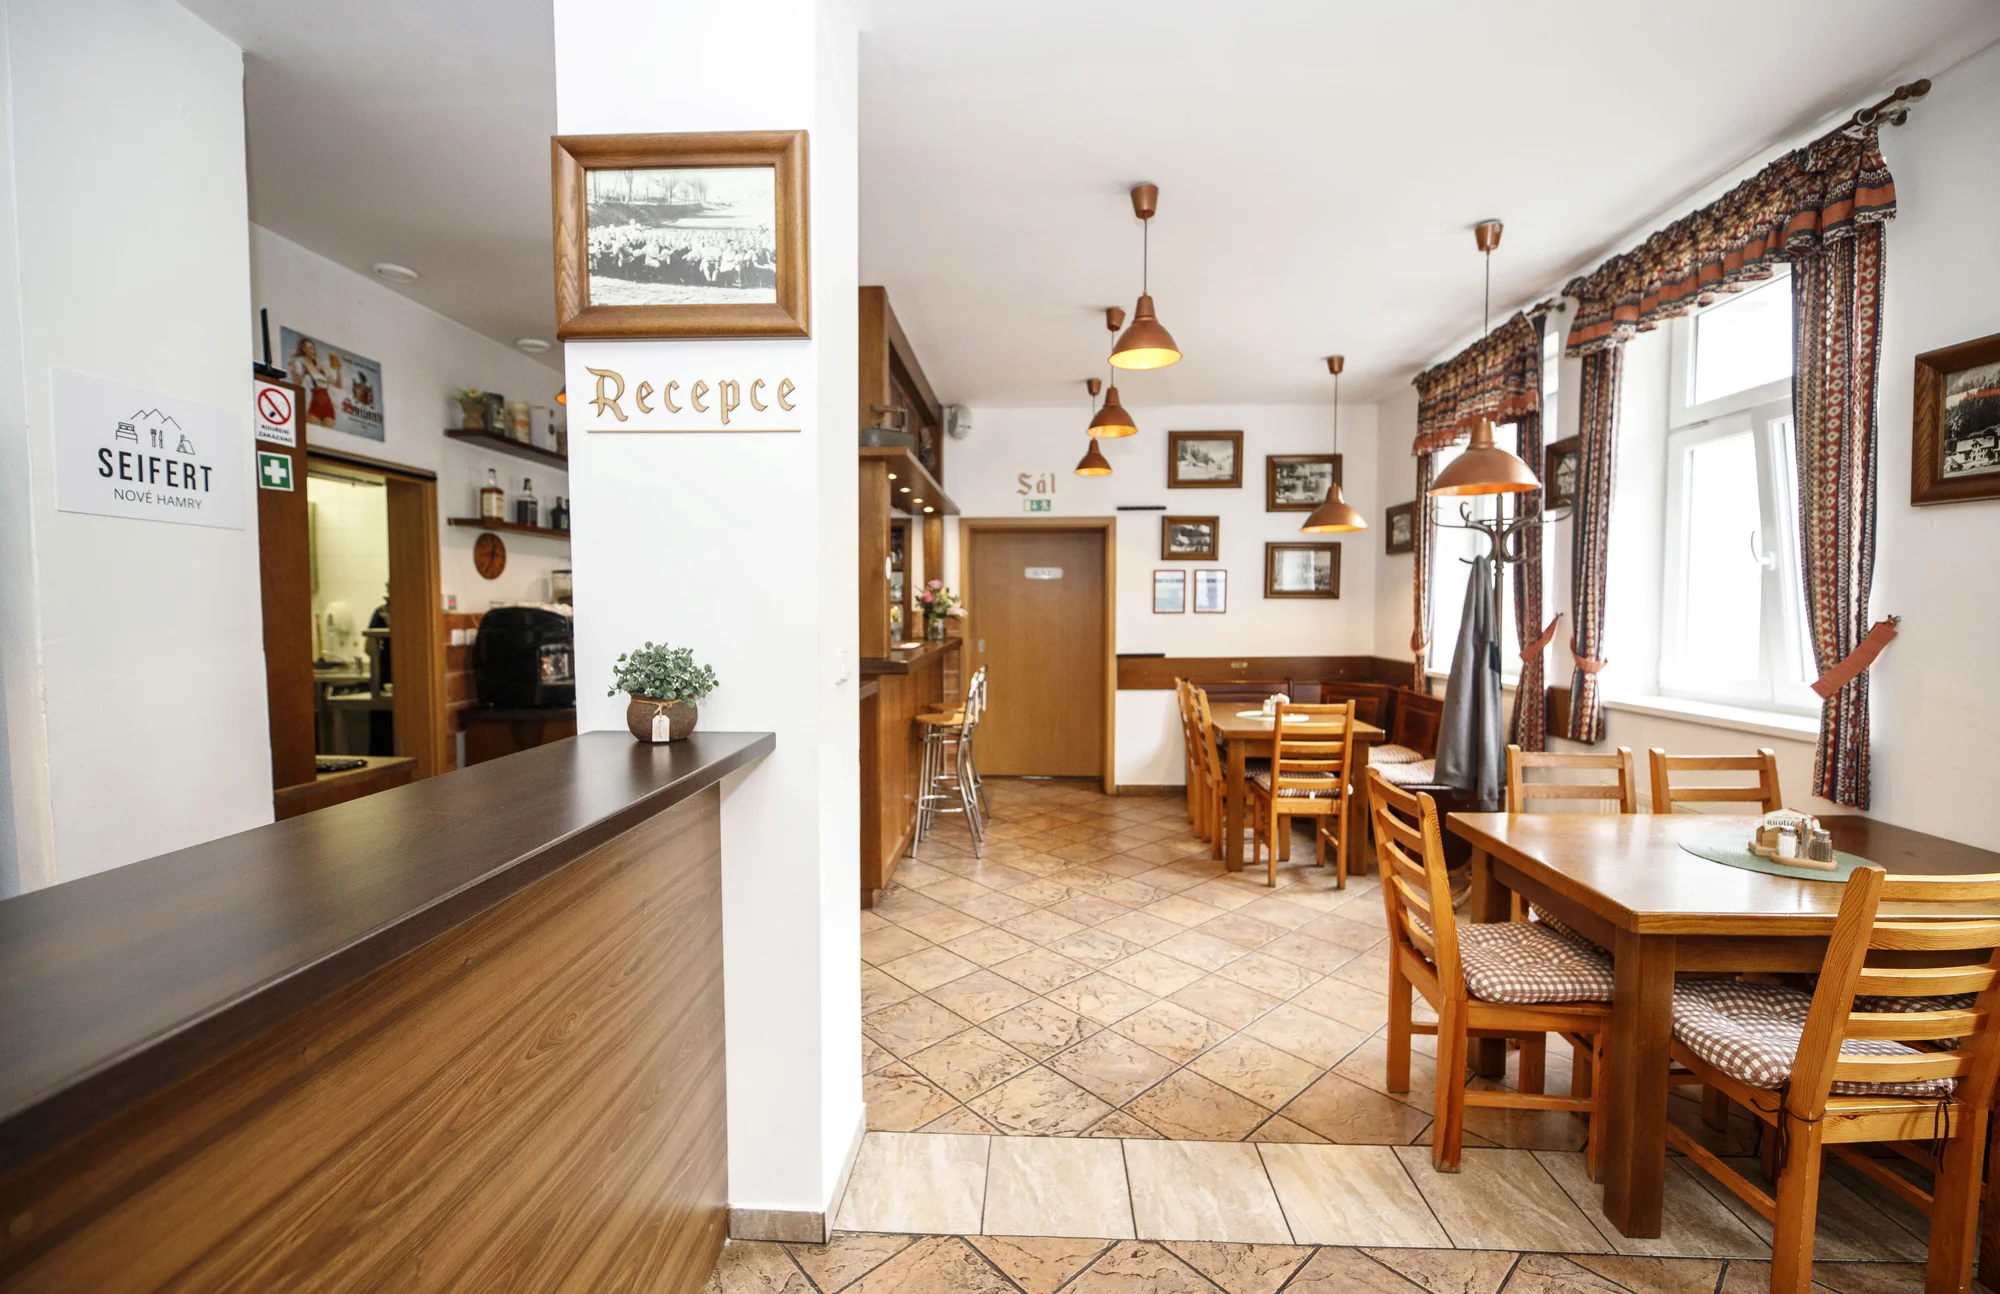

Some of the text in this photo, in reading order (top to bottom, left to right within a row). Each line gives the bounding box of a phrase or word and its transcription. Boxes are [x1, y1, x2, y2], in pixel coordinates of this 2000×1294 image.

[585, 366, 796, 425] Recepce
[98, 447, 212, 492] SEIFERT
[1016, 472, 1056, 496] Sál
[114, 488, 202, 510] NOVÉ HAMRY
